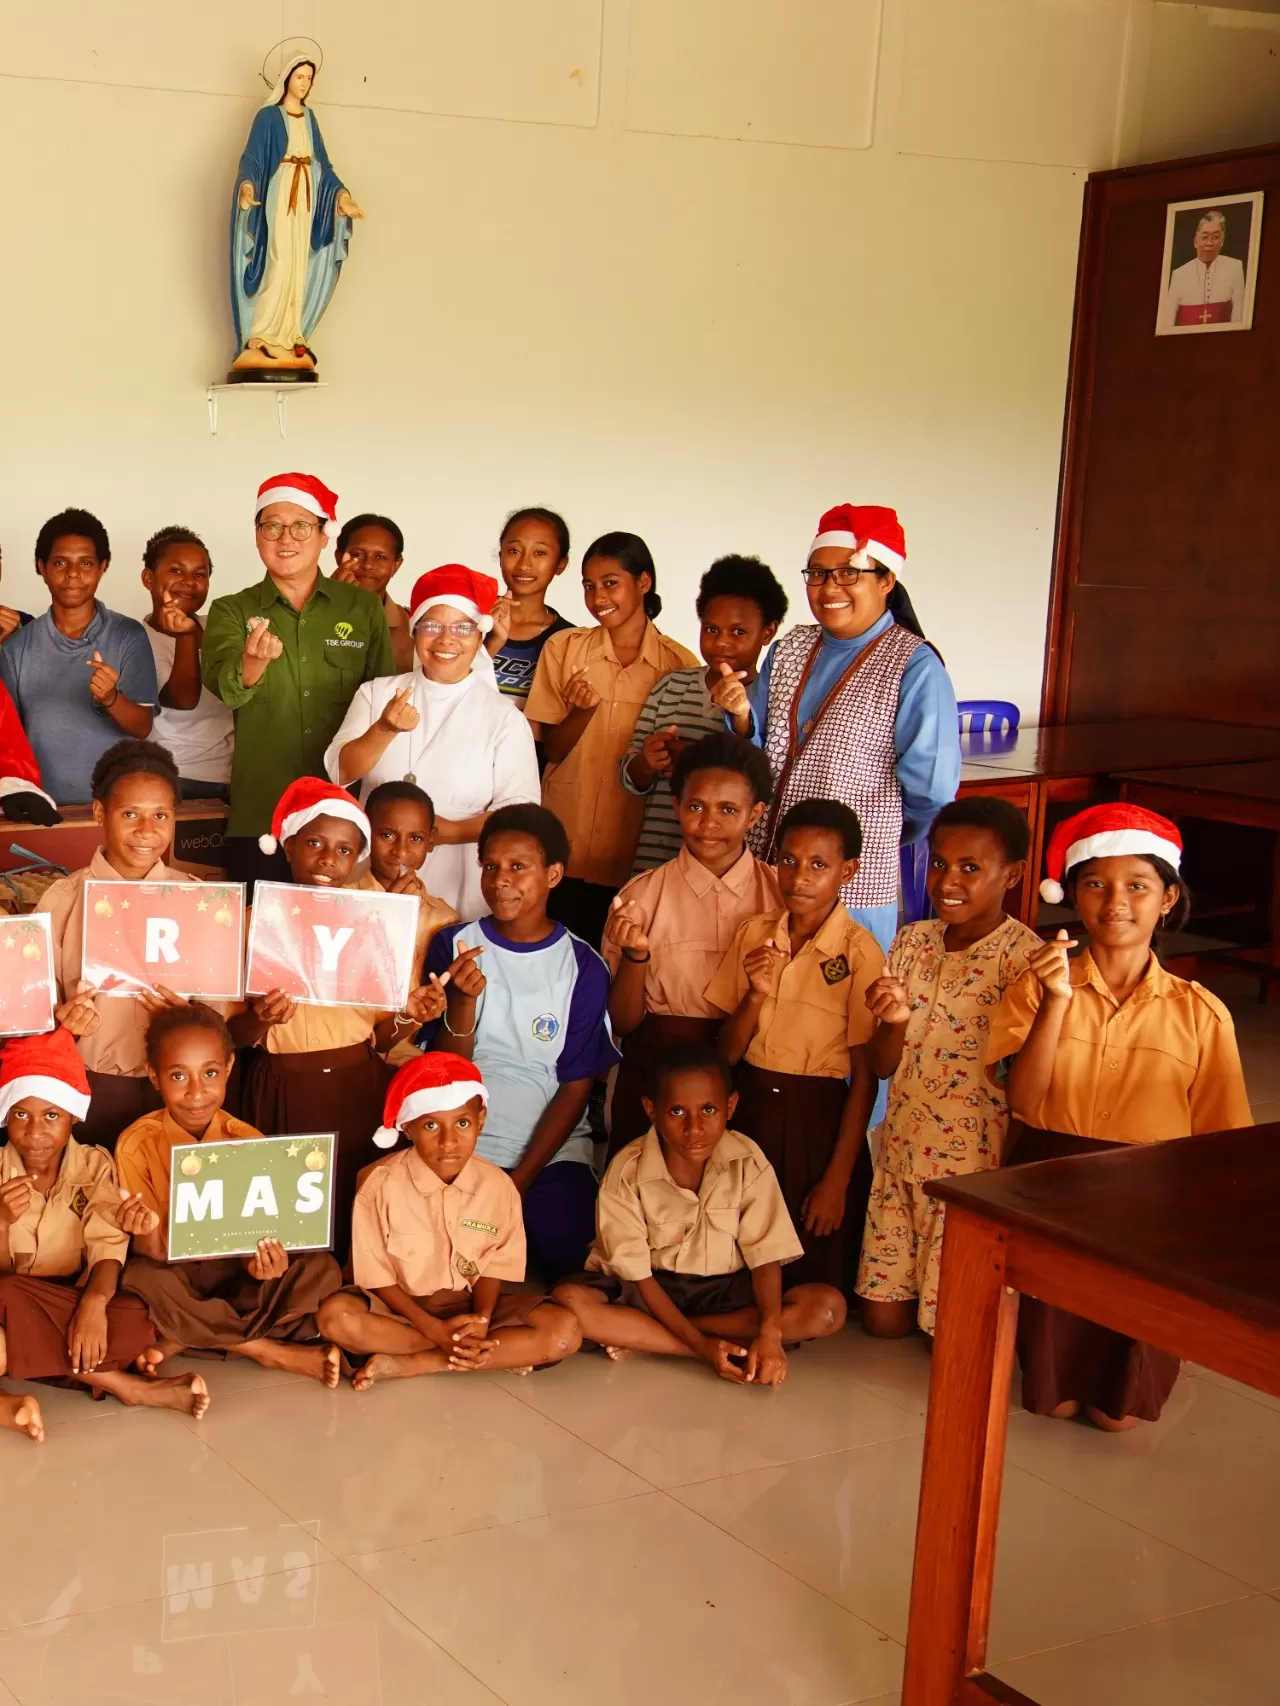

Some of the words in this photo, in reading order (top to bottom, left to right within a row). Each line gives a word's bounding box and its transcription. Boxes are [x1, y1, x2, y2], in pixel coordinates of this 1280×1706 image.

[324, 639, 340, 647] TSE
[340, 640, 365, 649] GROUP
[180, 832, 225, 850] webO
[145, 917, 181, 964] R
[311, 924, 356, 973] Y
